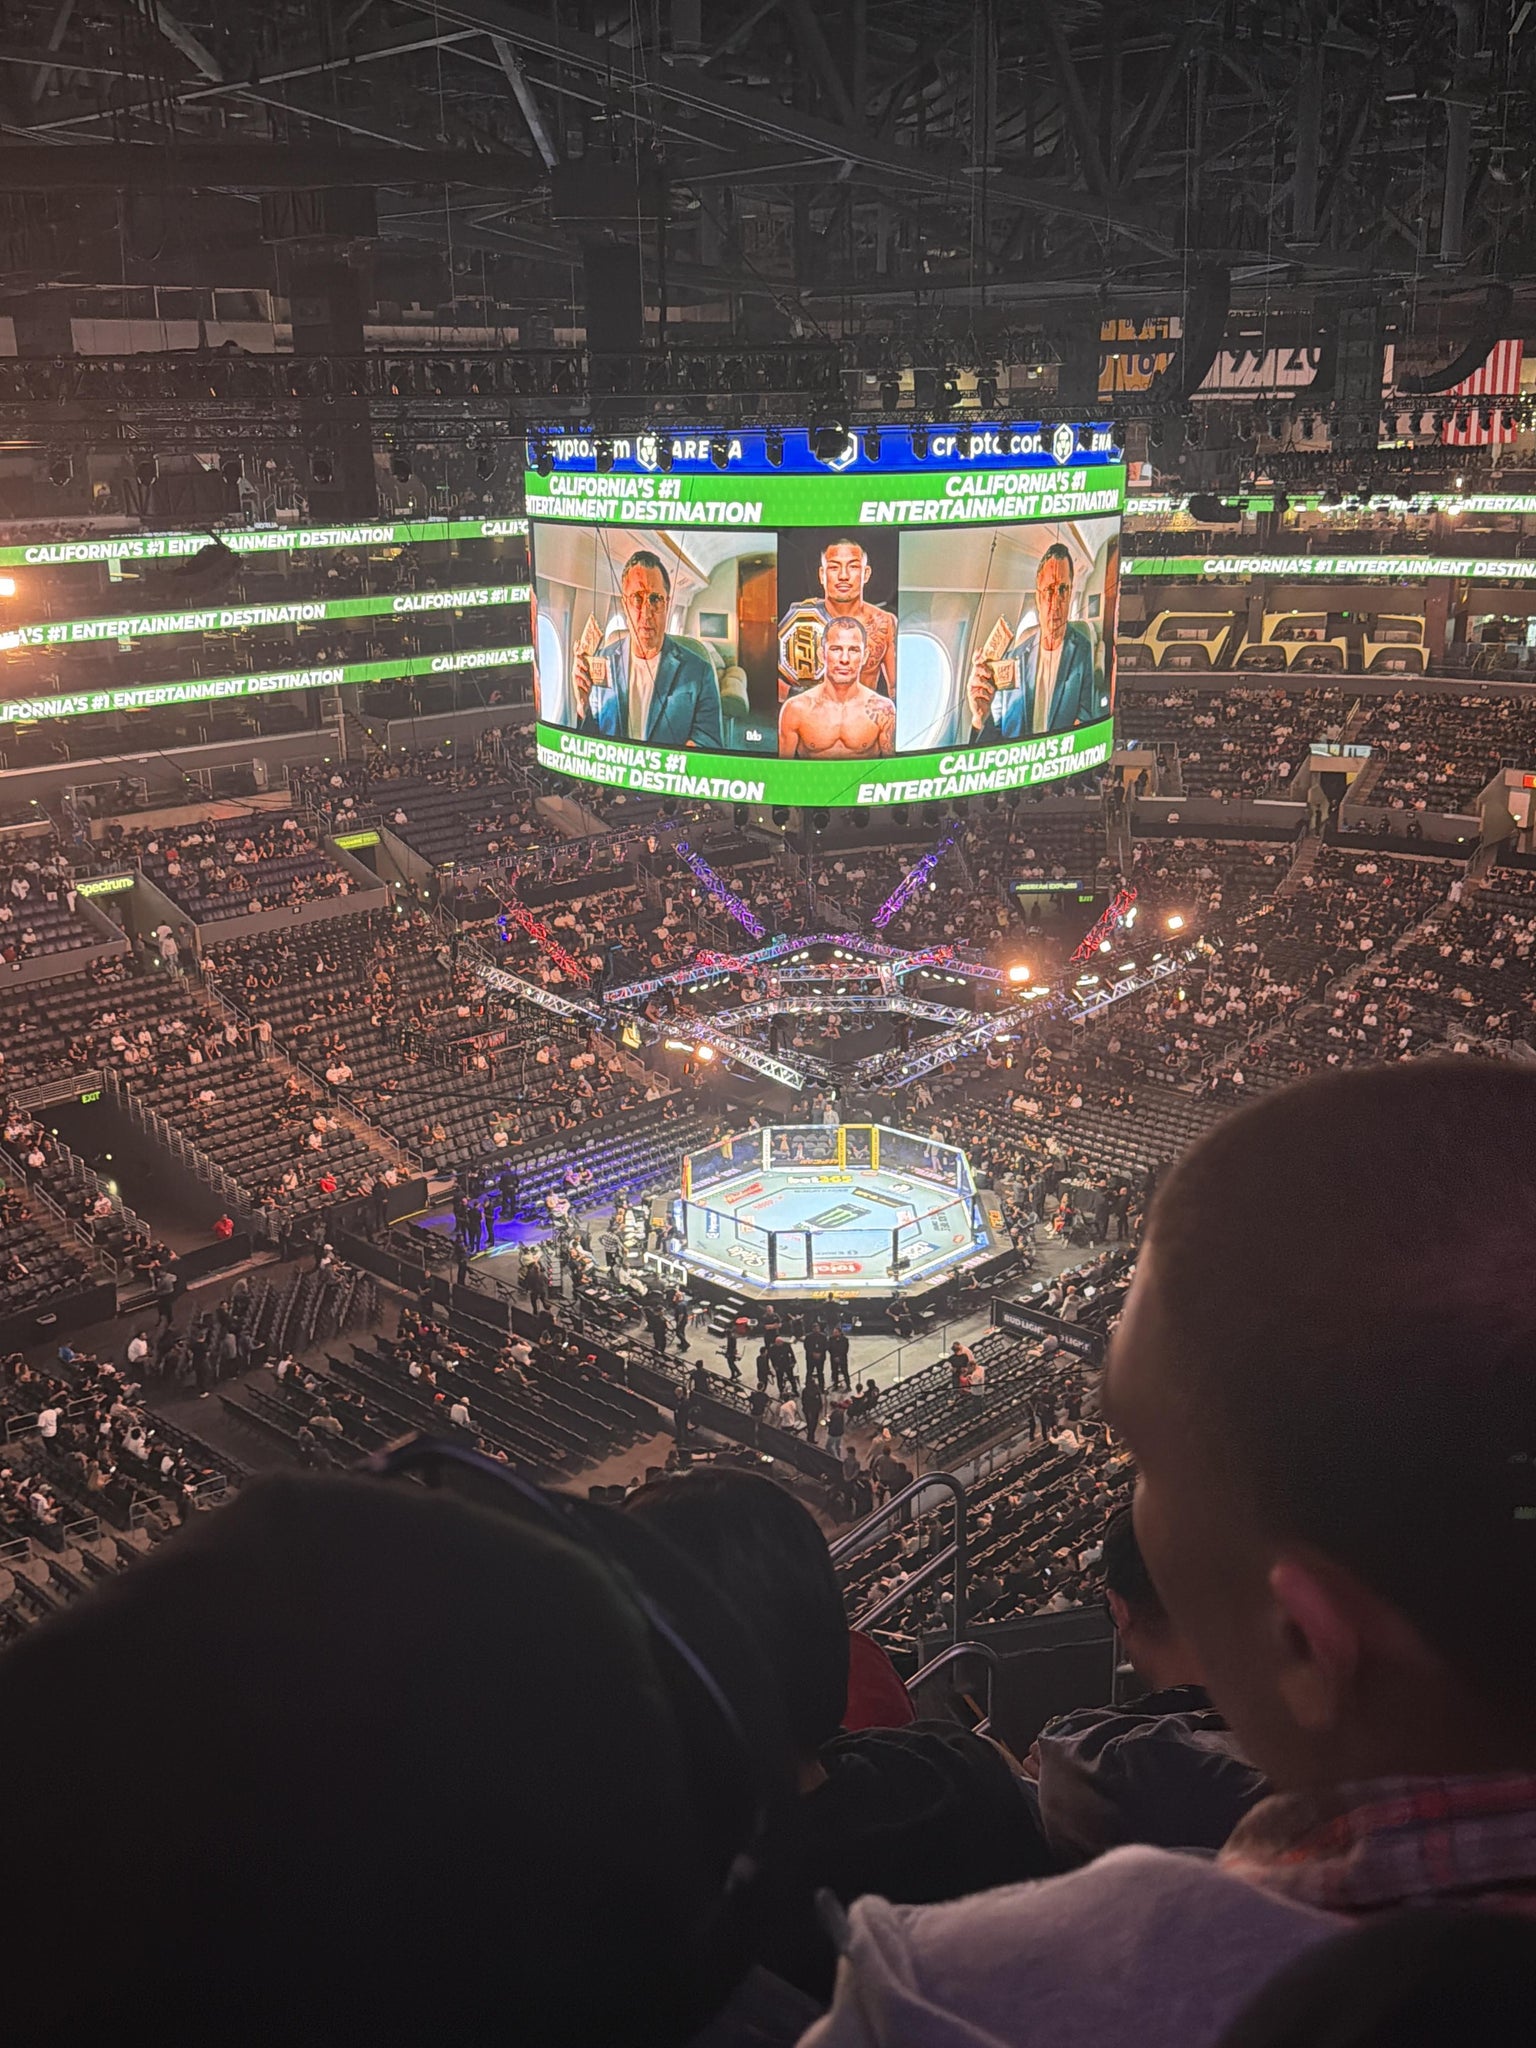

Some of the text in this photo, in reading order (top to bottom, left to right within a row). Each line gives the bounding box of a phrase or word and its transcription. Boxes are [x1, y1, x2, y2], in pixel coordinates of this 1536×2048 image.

[672, 440, 742, 459] AREA
[549, 475, 682, 499] CALIFORNIA'S #1
[945, 470, 1087, 497] CALIFORNIA'S #1
[621, 501, 763, 523] DESTINATION
[858, 489, 1119, 523] ENTERTAINMENT DESTINATION
[25, 540, 144, 563] CALIFORNIA'S
[146, 540, 165, 556] #1
[299, 528, 394, 546] DESTINATION
[1203, 559, 1312, 573] CALIFORNIA'S
[1314, 559, 1334, 573] #1
[1335, 560, 1475, 575] ENTERTAINMENT
[393, 589, 489, 612] CALIFORNIA'S
[46, 625, 68, 642] #1
[72, 613, 218, 640] ENTERTAINMENT
[220, 604, 326, 626] DESTINATION
[431, 650, 519, 672] CALIFORNIA'S
[91, 694, 110, 710] #1
[113, 680, 245, 708] ENTERTAINMENT
[247, 669, 344, 690] DESTINATION
[560, 735, 687, 774] CALIFORNIA'S #1
[939, 738, 1059, 775] CALIFORNIA'S
[629, 769, 766, 801] DESTINATION
[856, 742, 1107, 803] ENTERTAINMENT DESTINATION
[76, 878, 134, 897] Spectrum
